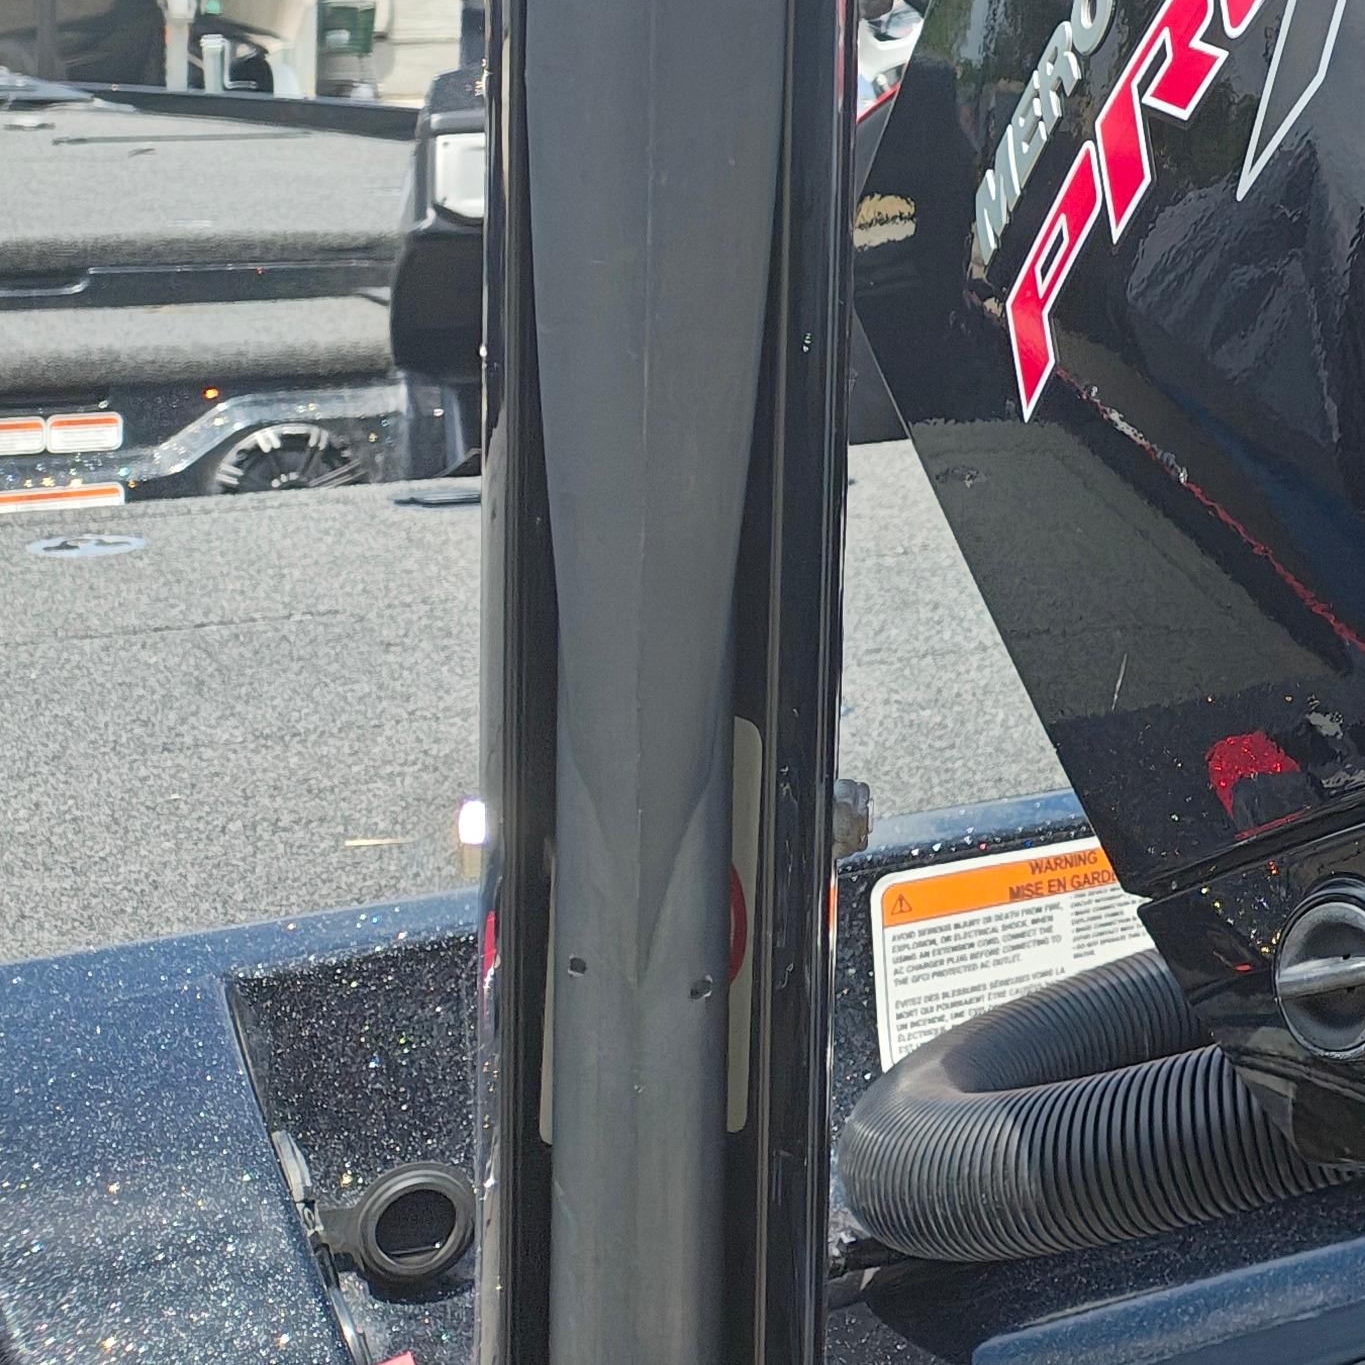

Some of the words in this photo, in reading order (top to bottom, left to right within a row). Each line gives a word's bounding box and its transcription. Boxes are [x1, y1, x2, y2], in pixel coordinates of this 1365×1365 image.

[1030, 851, 1097, 875] WARNING
[1010, 882, 1042, 899] MISE
[1048, 877, 1066, 893] EN
